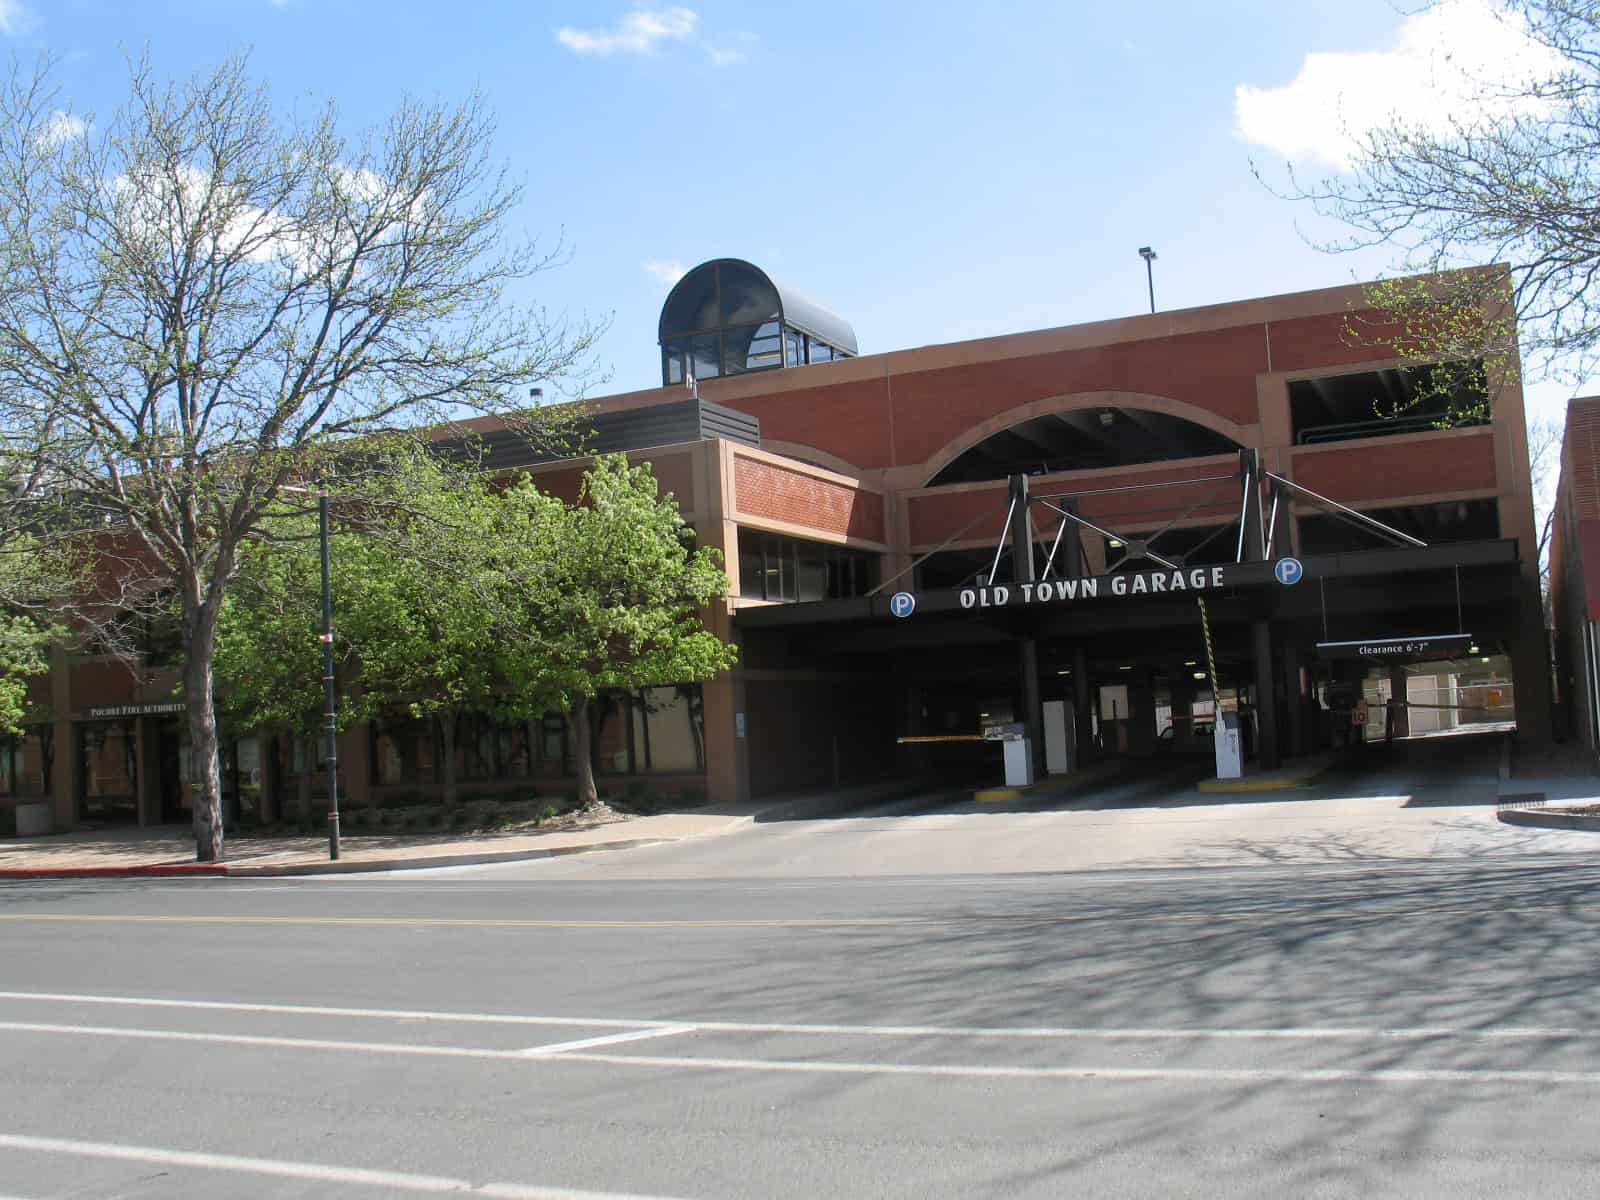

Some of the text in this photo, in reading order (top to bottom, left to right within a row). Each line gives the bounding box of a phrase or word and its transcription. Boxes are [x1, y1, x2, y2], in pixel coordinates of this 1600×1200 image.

[1280, 561, 1300, 583] P
[960, 567, 1224, 608] OLD TOWN GARAGE
[895, 596, 910, 617] P
